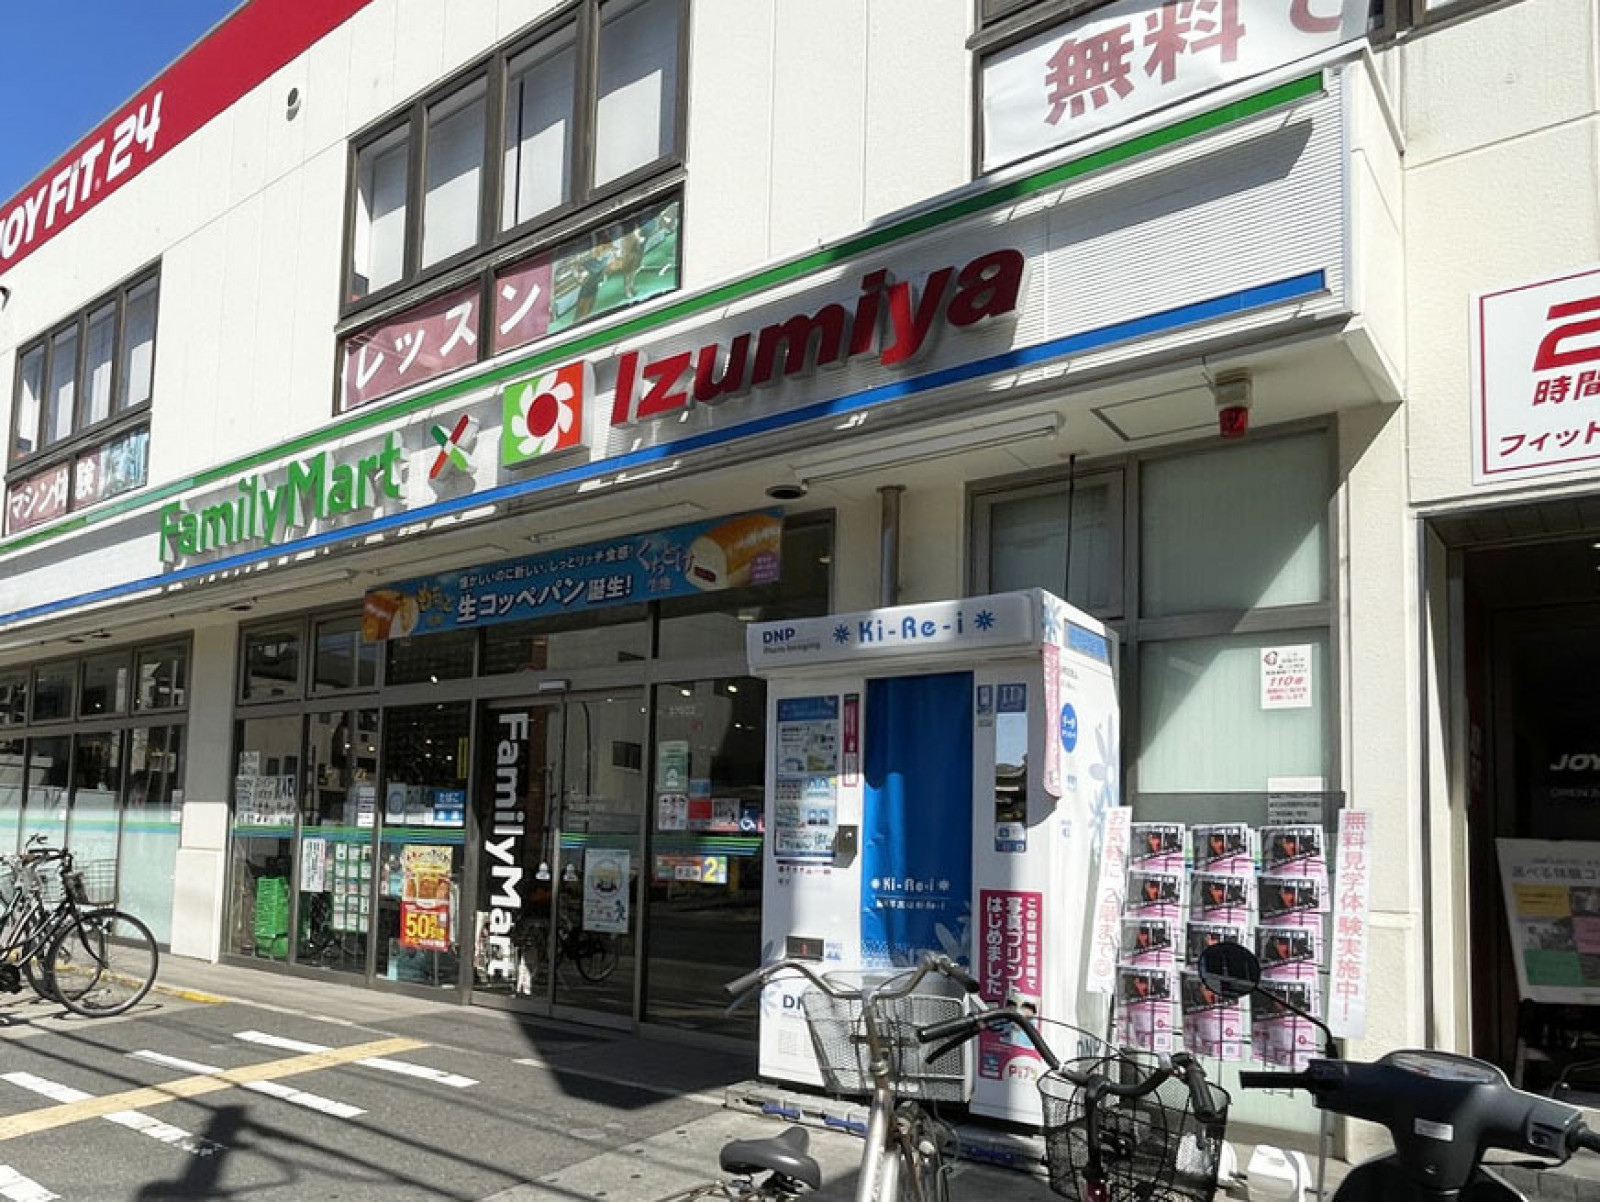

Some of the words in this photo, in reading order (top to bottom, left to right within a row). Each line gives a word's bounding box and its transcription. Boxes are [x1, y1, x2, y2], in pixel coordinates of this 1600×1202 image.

[0, 138, 105, 260] OYFIT
[106, 91, 163, 182] 24
[356, 283, 541, 390] レッスン
[611, 249, 1024, 427] Izumiya
[159, 432, 402, 562] FamilyMart
[763, 627, 795, 645] DNP
[858, 611, 964, 643] Ki-Re-i
[485, 713, 529, 978] FamilyMart
